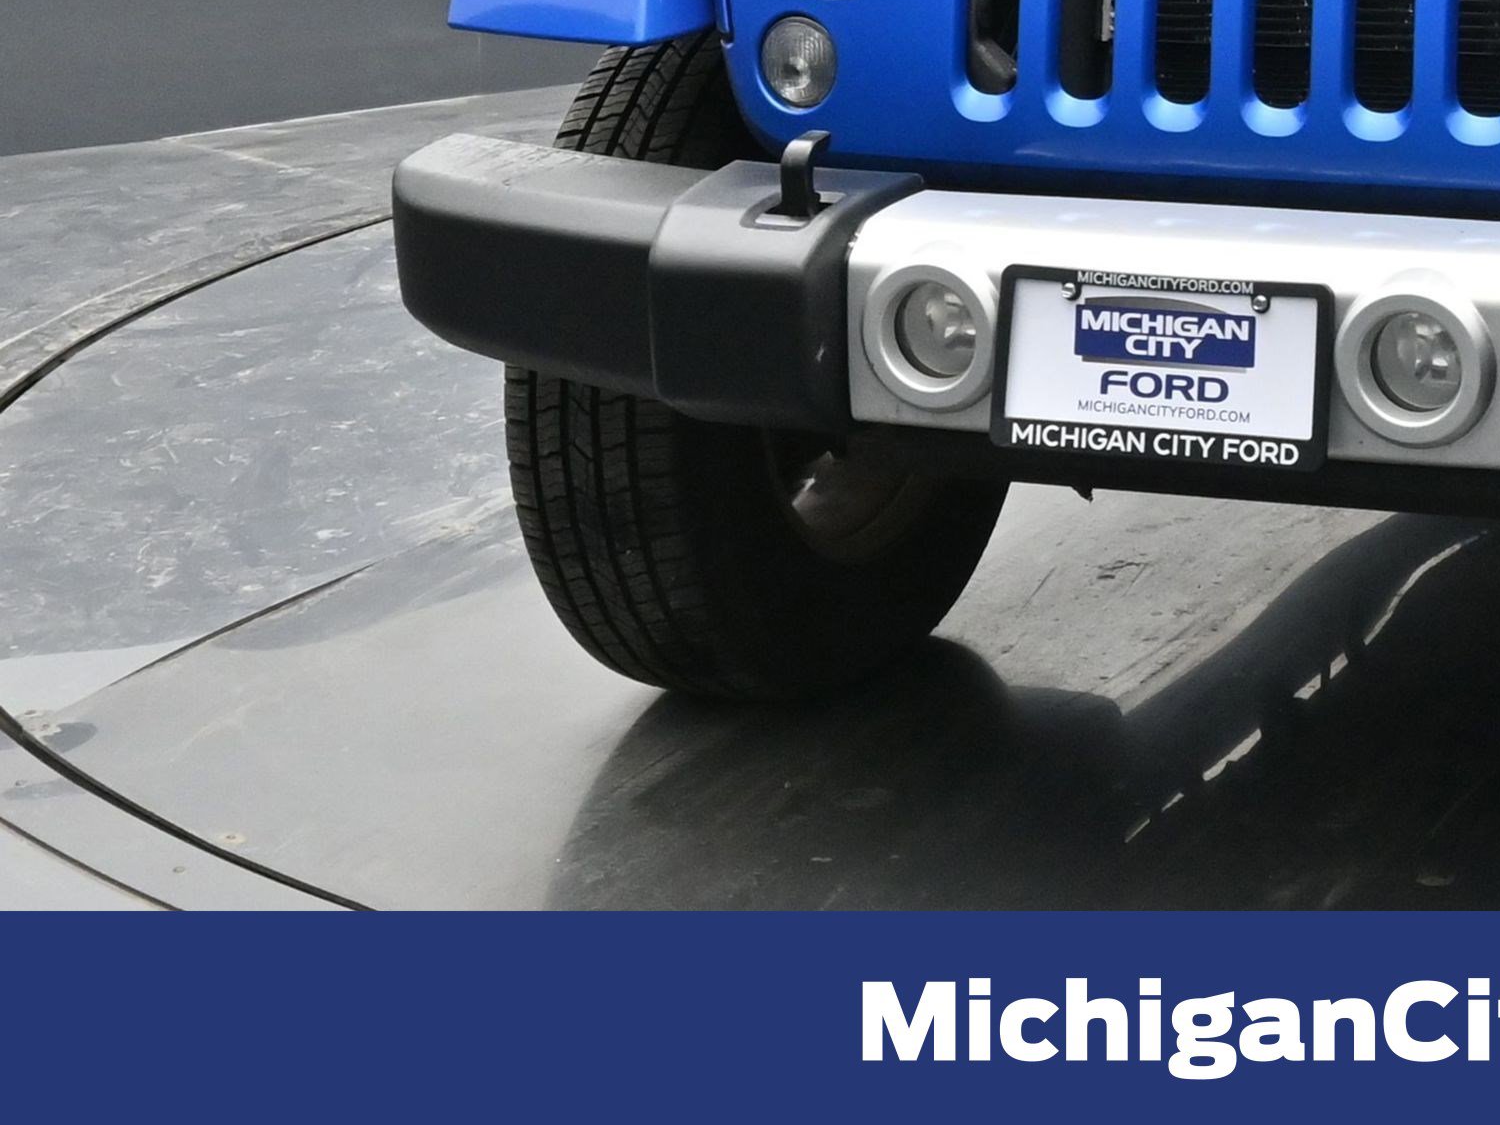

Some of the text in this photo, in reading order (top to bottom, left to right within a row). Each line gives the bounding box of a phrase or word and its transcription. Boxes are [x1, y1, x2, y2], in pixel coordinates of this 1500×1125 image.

[1076, 270, 1254, 295] MICHIGANCITYFORD.COM
[1081, 309, 1249, 341] MICHIGAN
[1125, 335, 1203, 360] CITY
[1099, 370, 1230, 404] FORD
[1077, 399, 1251, 424] MICHIGANCITYFORD.COM
[1011, 422, 1300, 466] MICHIGAN CITY FORD
